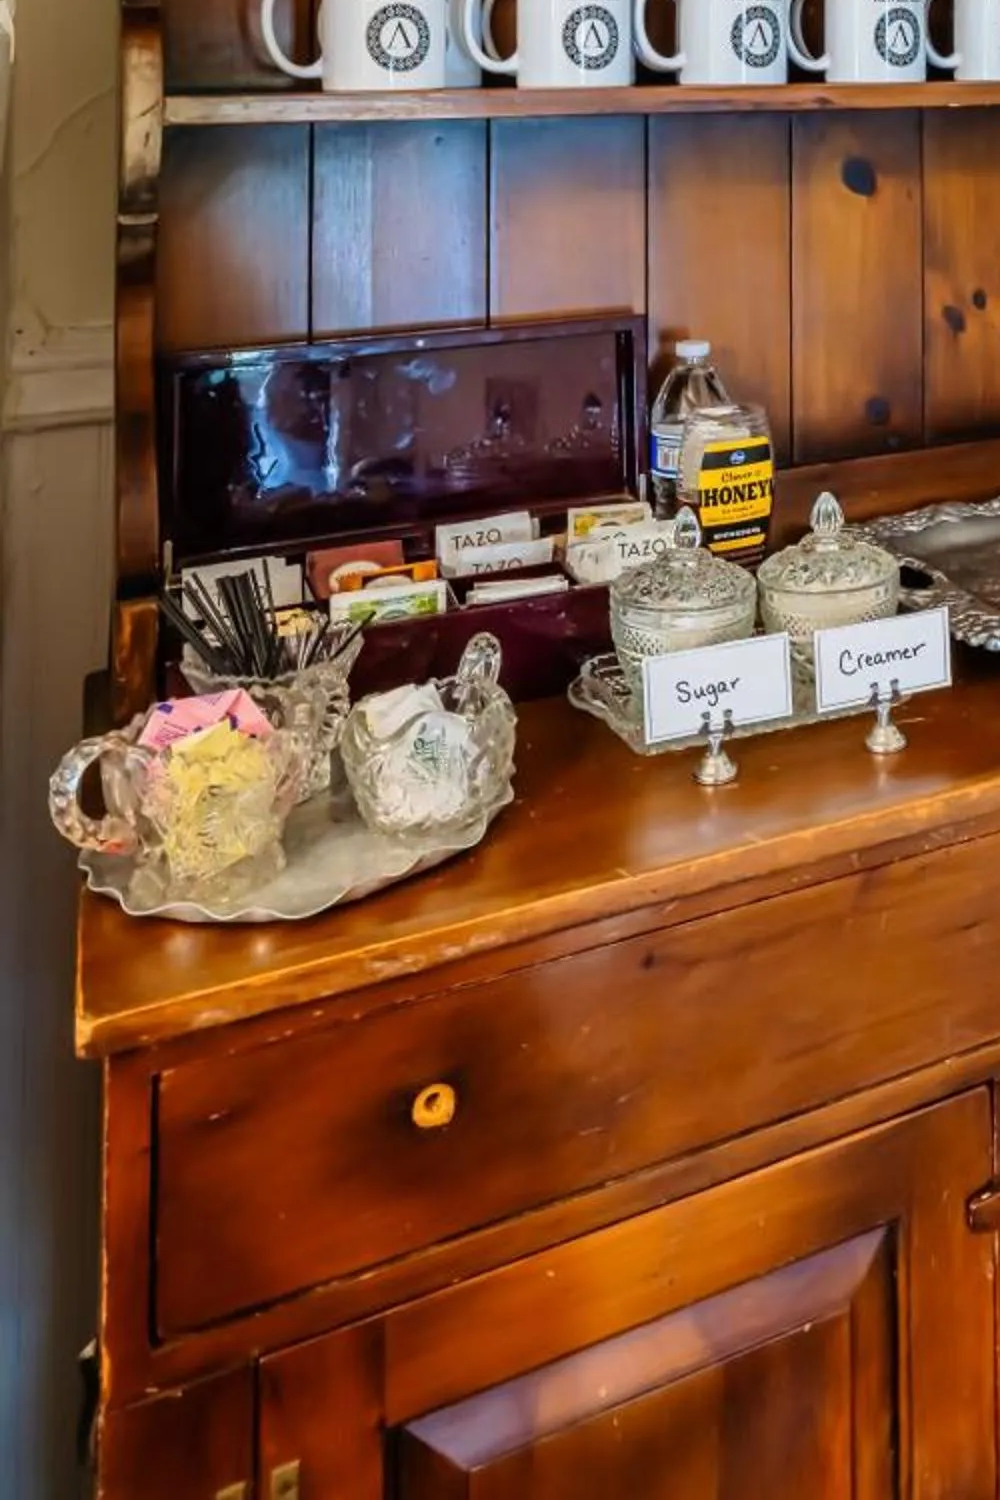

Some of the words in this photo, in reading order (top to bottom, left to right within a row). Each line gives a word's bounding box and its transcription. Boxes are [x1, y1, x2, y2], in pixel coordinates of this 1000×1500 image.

[703, 481, 769, 508] HONEY
[451, 528, 502, 550] TAZO
[617, 538, 667, 559] TAZO
[839, 642, 926, 676] Creamer
[675, 675, 741, 706] Sugar
